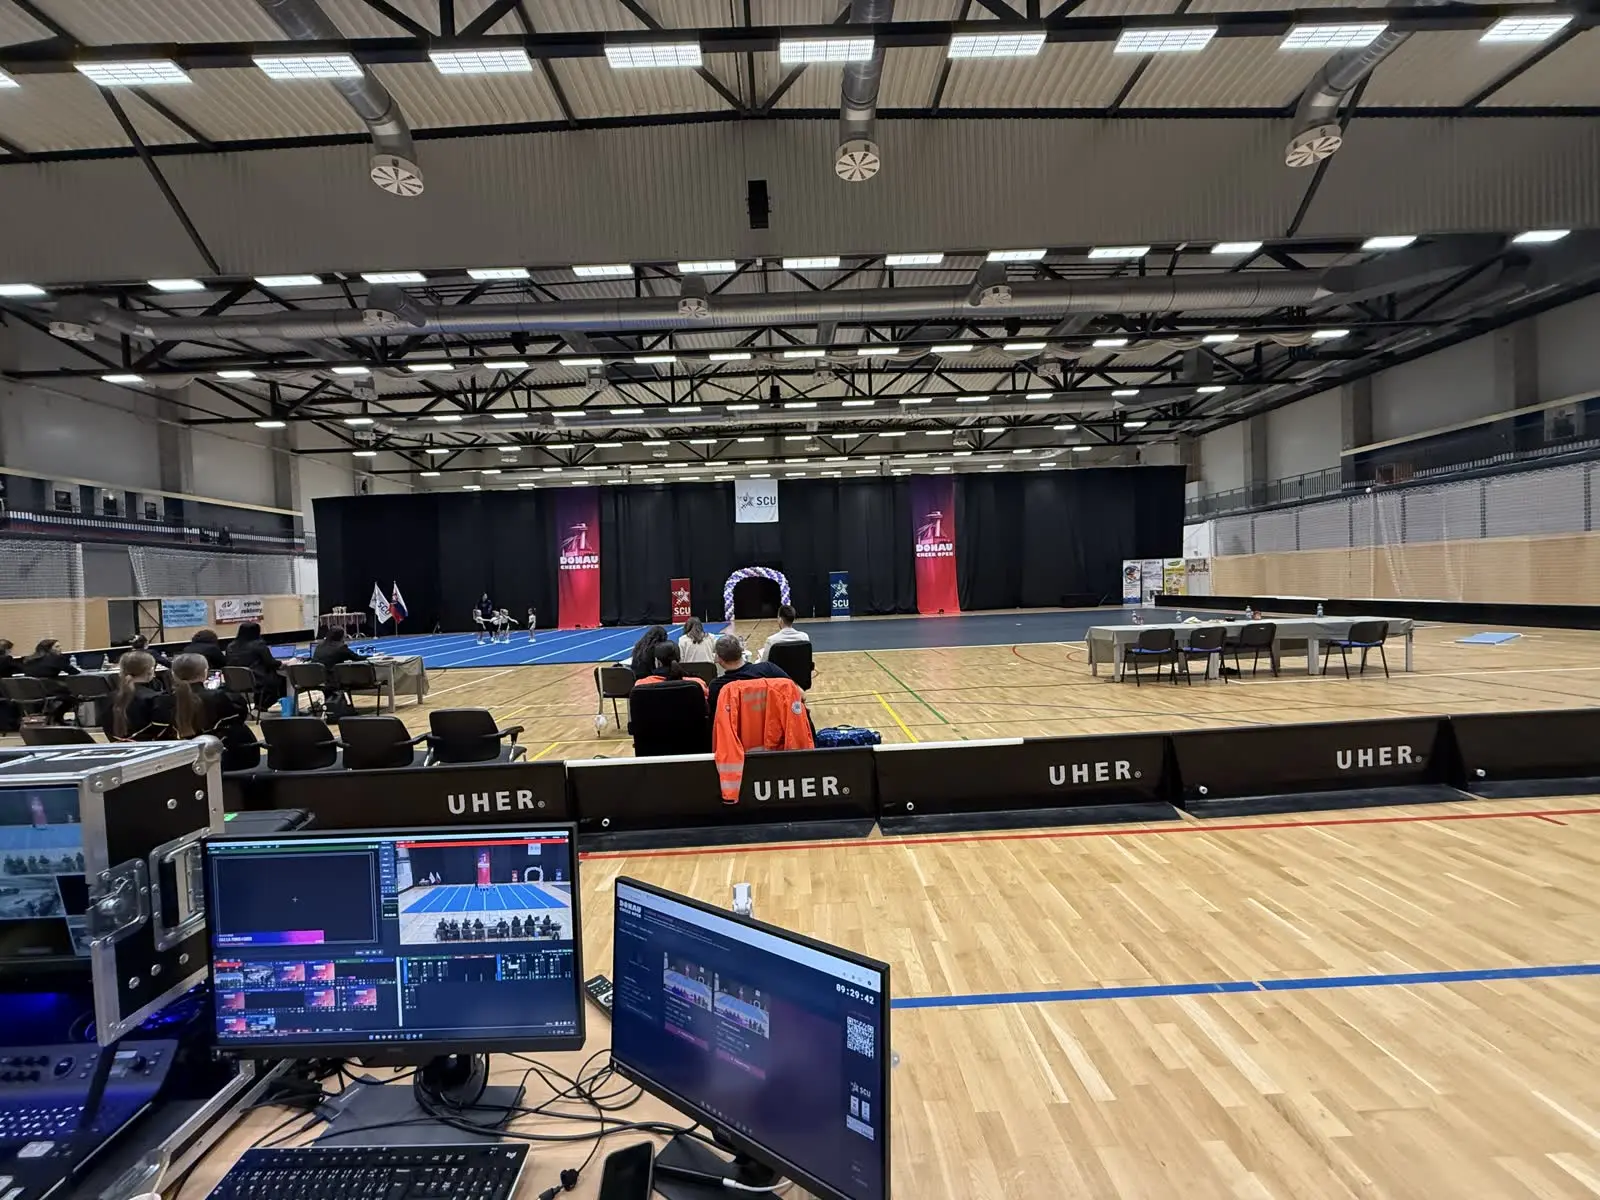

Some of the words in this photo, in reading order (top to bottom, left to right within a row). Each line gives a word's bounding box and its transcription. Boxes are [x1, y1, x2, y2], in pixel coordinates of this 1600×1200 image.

[756, 496, 777, 506] SCU
[915, 543, 953, 552] DONAU
[560, 555, 599, 564] DONAU
[832, 599, 849, 608] SCU
[673, 607, 691, 616] SCU
[835, 983, 875, 1005] 09:29:42
